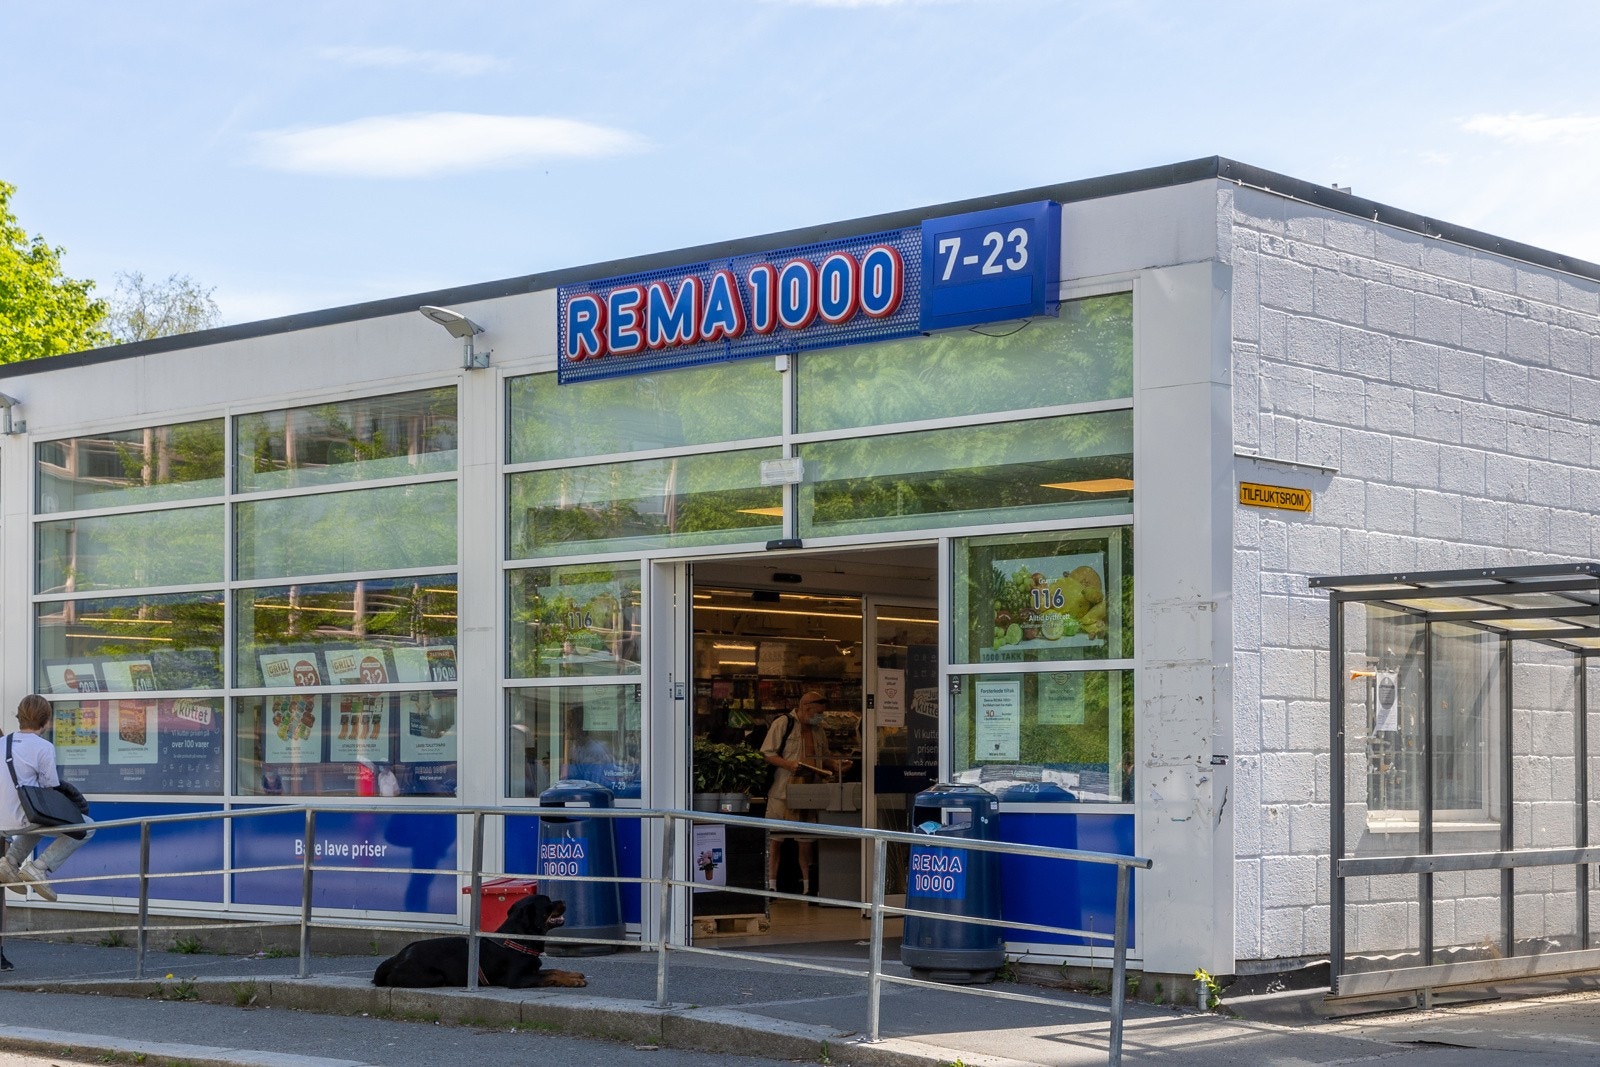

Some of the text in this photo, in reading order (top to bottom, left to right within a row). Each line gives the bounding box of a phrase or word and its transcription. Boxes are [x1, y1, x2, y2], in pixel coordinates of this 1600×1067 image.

[938, 227, 1029, 281] 7-23
[566, 244, 904, 362] REMA 1000
[1242, 487, 1304, 507] TILFLUKTSROM
[1031, 587, 1065, 610] 116
[568, 611, 592, 630] 116
[333, 658, 355, 671] GRILL
[1002, 652, 1021, 661] TAKK
[269, 663, 289, 674] GRILL
[178, 703, 208, 723] kuttet
[917, 700, 938, 717] kutte
[184, 739, 194, 748] 100
[611, 782, 626, 790] 7-23
[1021, 784, 1040, 793] 7-23
[295, 839, 387, 859] Be lave priser
[540, 843, 584, 859] REMA
[543, 861, 578, 876] 1000
[912, 854, 962, 873] REMA
[915, 874, 954, 892] 1000
